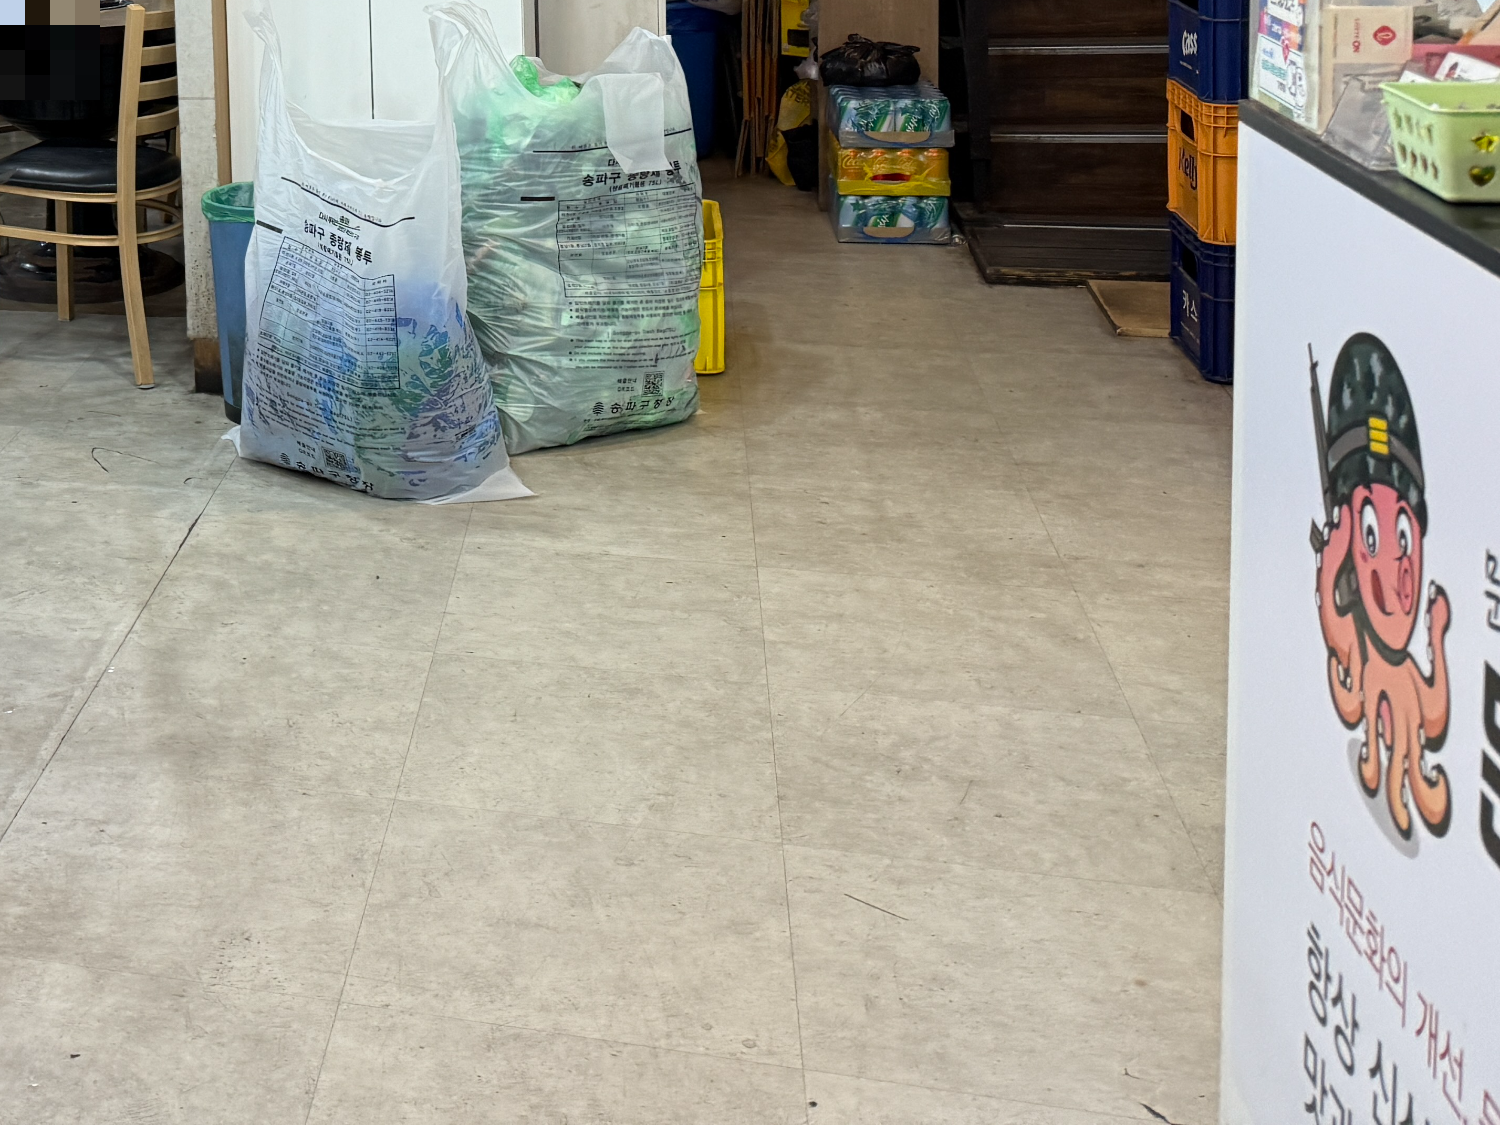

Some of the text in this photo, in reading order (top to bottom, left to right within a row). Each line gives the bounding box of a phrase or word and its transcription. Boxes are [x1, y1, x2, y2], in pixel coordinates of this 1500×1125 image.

[1182, 30, 1198, 57] Cass
[582, 172, 621, 187] 송파구
[1179, 147, 1198, 191] Kelly
[304, 219, 325, 240] 송파구
[329, 232, 352, 256] 종량제
[354, 245, 373, 265] 봉투
[1182, 289, 1198, 323] 카스
[1307, 821, 1408, 1029] 음식문화의
[1306, 921, 1359, 1076] 항상
